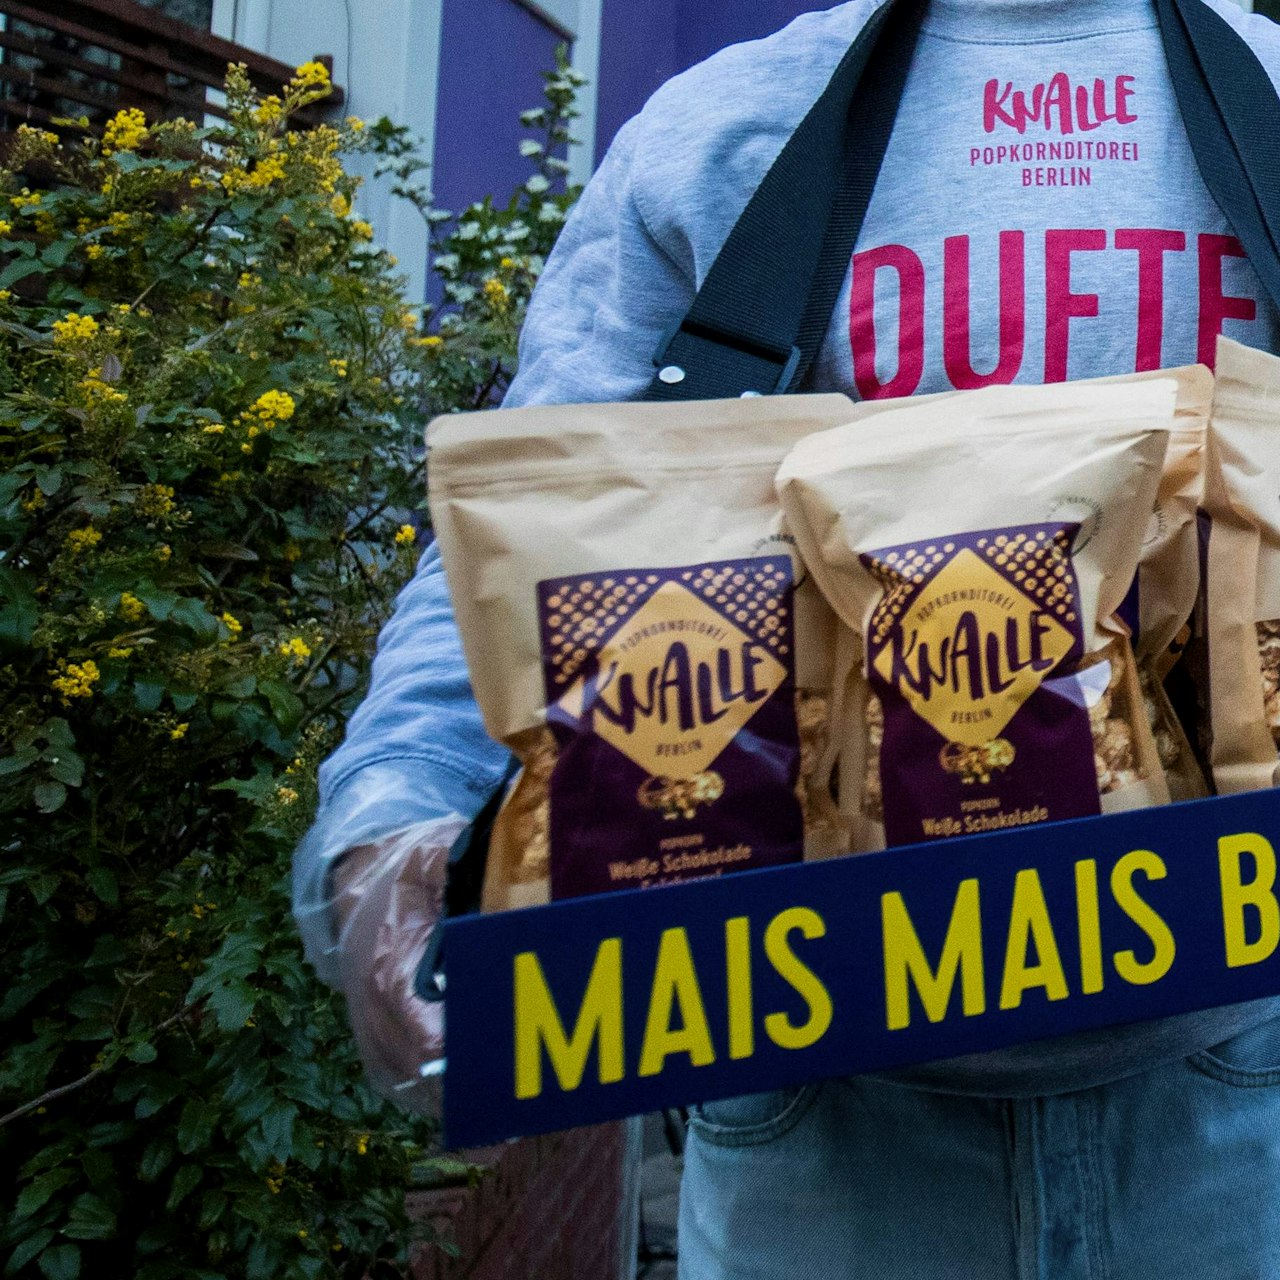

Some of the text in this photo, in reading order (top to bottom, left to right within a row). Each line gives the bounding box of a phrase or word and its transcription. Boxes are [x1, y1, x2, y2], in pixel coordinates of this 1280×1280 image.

[982, 71, 1138, 135] KNALLE
[970, 141, 1138, 166] POPKORNDITOREI
[1021, 167, 1091, 187] BERLIN
[892, 609, 1055, 702] KNALLE
[513, 906, 833, 1100] MAIS
[880, 849, 1177, 1031] MAIS
